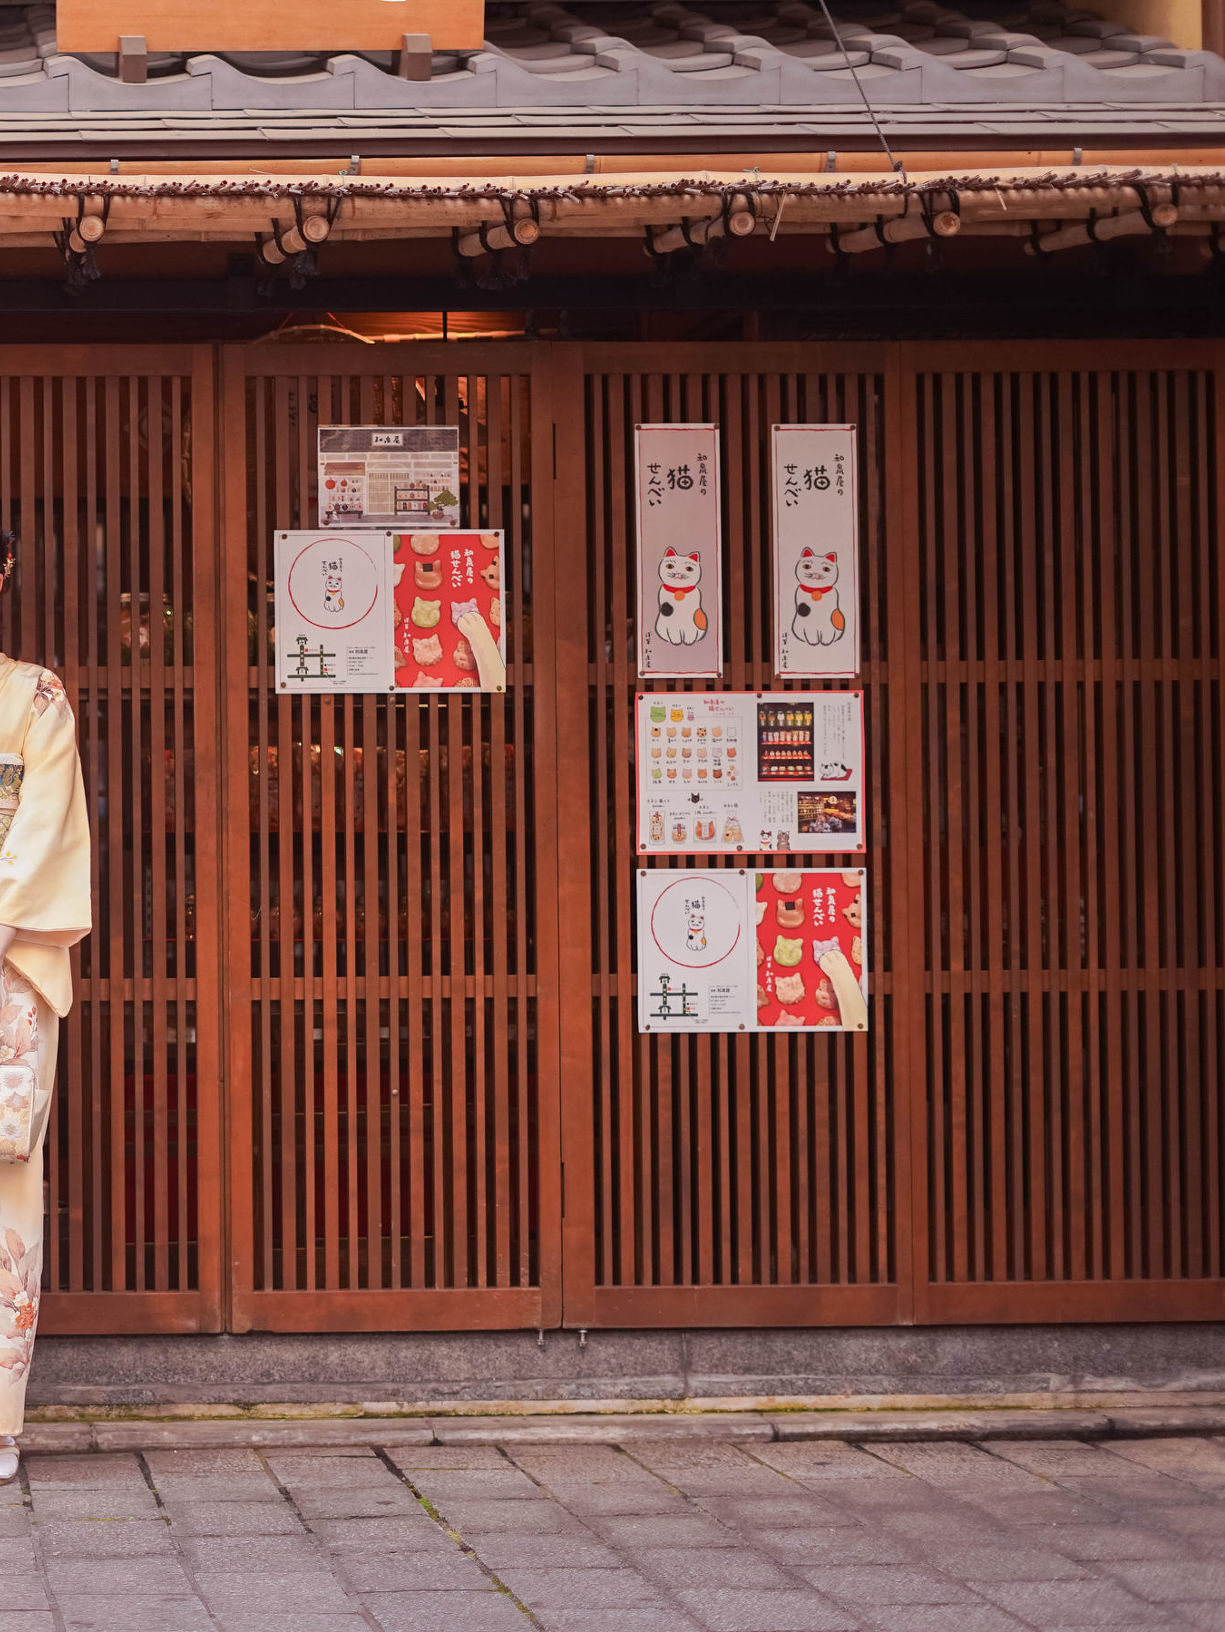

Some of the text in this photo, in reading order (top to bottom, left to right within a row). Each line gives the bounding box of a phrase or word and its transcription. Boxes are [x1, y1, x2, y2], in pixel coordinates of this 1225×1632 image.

[646, 462, 666, 507] せんべい
[666, 464, 694, 490] 猫
[783, 463, 802, 507] せんべい
[803, 464, 831, 491] 猫
[450, 549, 463, 588] 猫せんべい
[812, 887, 825, 927] 猫せんべい
